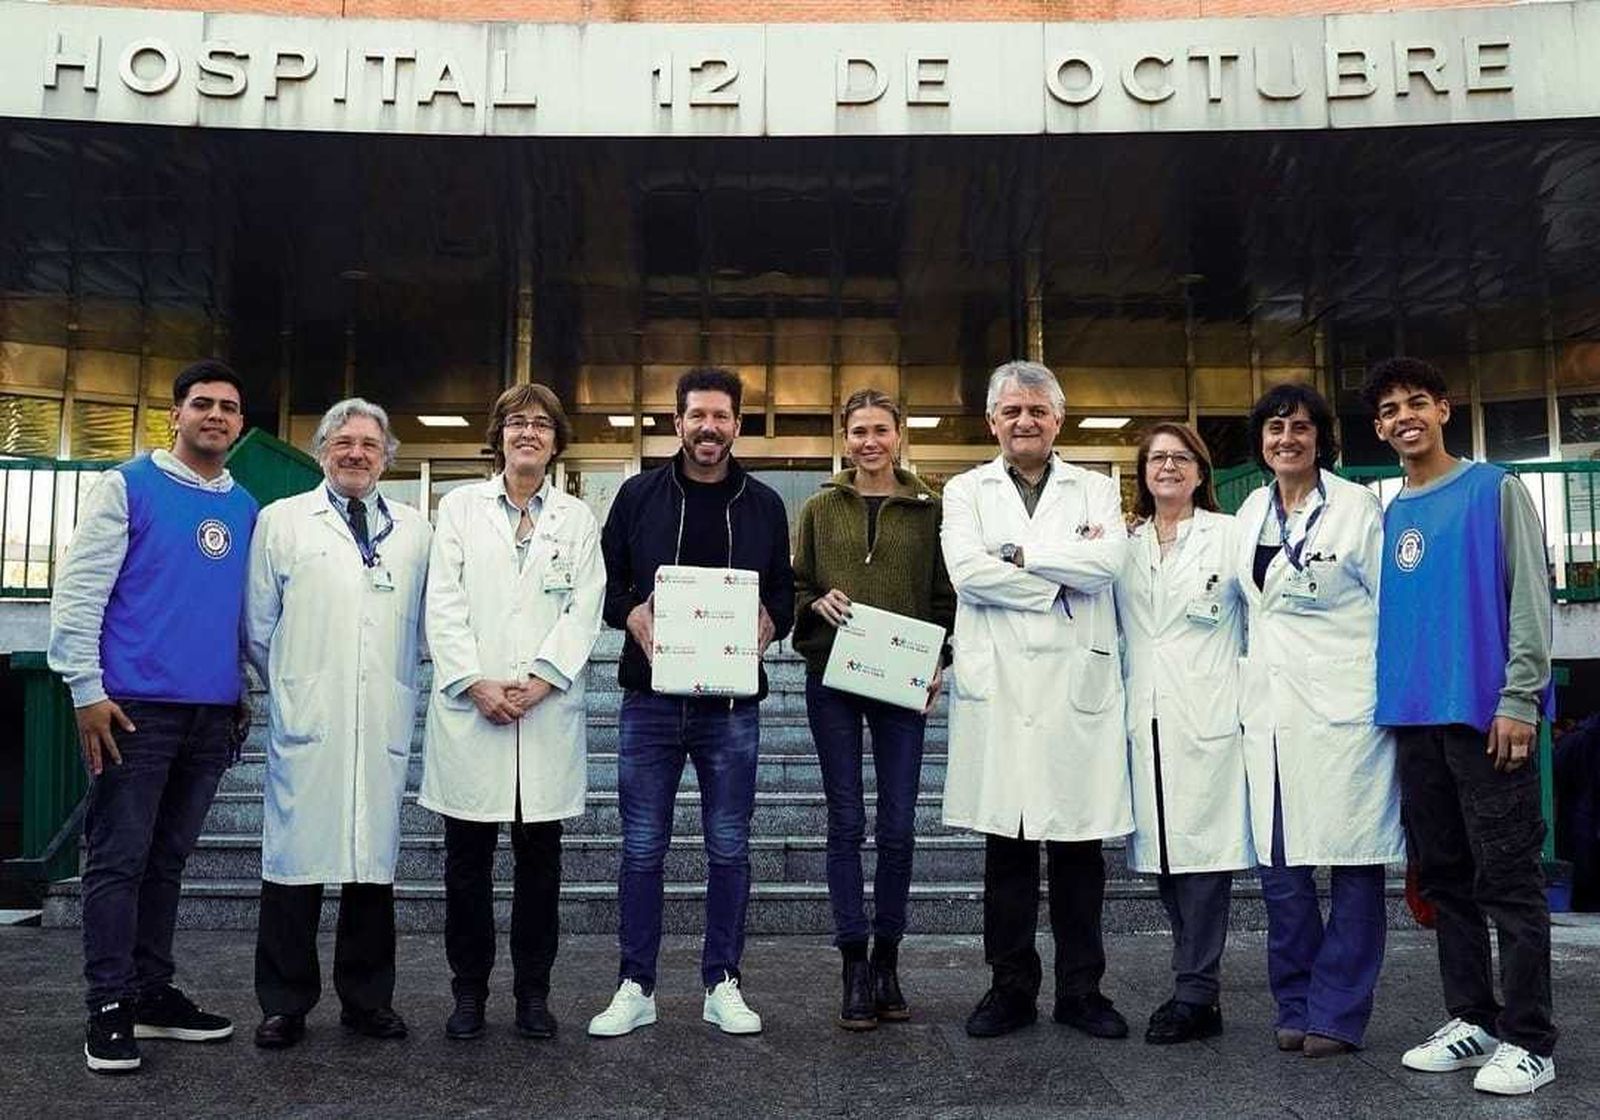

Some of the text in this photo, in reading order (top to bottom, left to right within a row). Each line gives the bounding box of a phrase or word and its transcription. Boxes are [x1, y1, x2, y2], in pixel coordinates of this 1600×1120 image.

[43, 34, 1514, 108] HOSPITAL 12 DE OCTUBRE
